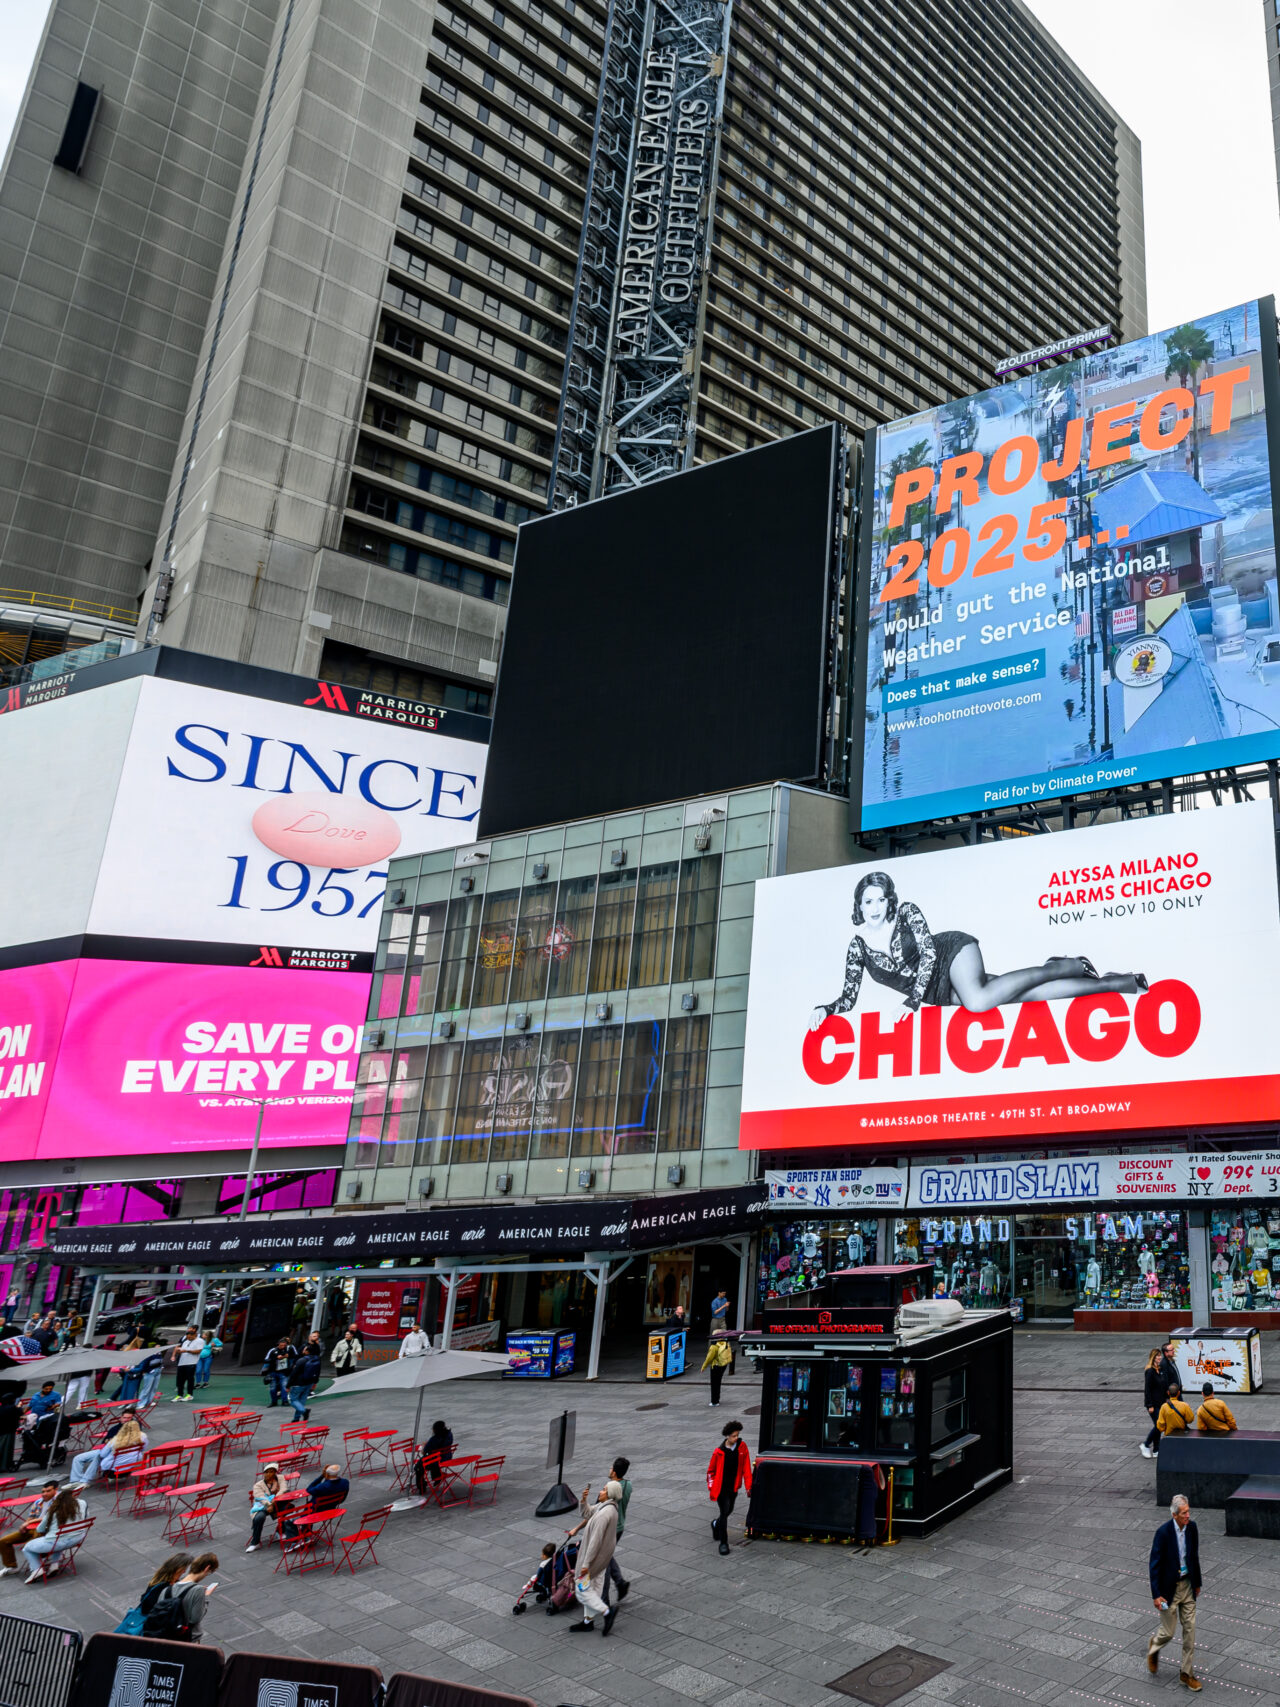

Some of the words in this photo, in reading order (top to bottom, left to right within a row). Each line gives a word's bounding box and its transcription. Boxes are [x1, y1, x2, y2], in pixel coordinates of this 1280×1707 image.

[888, 366, 1250, 529] PROJECT
[883, 604, 943, 637] would
[956, 593, 994, 623] gut
[1008, 581, 1047, 605] the
[1060, 547, 1171, 592] National
[883, 633, 967, 668] Weather
[980, 608, 1071, 645] Service
[28, 673, 76, 693] MARRIOTT
[886, 688, 917, 704] Does
[921, 680, 951, 697] that
[955, 671, 987, 690] make
[991, 658, 1040, 681] sense?
[25, 687, 67, 706] MARQUIS
[361, 692, 448, 719] MARRIOTT
[359, 704, 436, 729] MARQUIS
[886, 691, 1042, 734] www.toohotnottovote.com
[166, 723, 481, 823] SINCE
[984, 787, 1010, 803] Paid
[1011, 784, 1030, 798] for
[1032, 781, 1045, 797] by
[1048, 772, 1094, 791] Climate
[1096, 765, 1138, 782] Power
[283, 810, 368, 842] Dove
[1048, 864, 1115, 888] ALYSSA
[1120, 852, 1199, 878] MILANO
[1038, 885, 1115, 909] CHARMS
[1120, 872, 1212, 898] CHICAGO
[1049, 910, 1085, 925] NOW
[1103, 903, 1136, 918] NOV
[1141, 901, 1156, 914] 10
[1162, 894, 1203, 911] ONLY
[290, 958, 349, 969] MARQUIS
[291, 949, 357, 962] MARRIOTT
[182, 1022, 312, 1054] SAVE
[802, 978, 1202, 1085] CHICAGO
[120, 1060, 296, 1094] EVERY
[198, 1099, 223, 1108] VS.
[297, 1096, 354, 1105] VERIZON
[868, 1114, 938, 1127] AMBASSADOR
[942, 1111, 987, 1122] THEATRE
[999, 1107, 1026, 1119] 49TH
[1029, 1107, 1046, 1118] ST.
[1049, 1105, 1063, 1116] AT
[1066, 1101, 1132, 1115] BROADWAY
[1118, 1159, 1174, 1170] DISCOUNT
[1188, 1155, 1198, 1163] #1
[1201, 1154, 1225, 1163] Rated
[1227, 1153, 1263, 1162] Souvenir
[786, 1171, 818, 1183] SPORTS
[820, 1170, 838, 1182] FAN
[840, 1169, 863, 1181] SHOP
[919, 1167, 1014, 1204] GRAND
[1016, 1162, 1100, 1199] SLAM
[1124, 1172, 1155, 1182] GIFTS
[1156, 1172, 1164, 1181] &
[1223, 1164, 1254, 1179] 99¢
[1116, 1183, 1177, 1194] SOUVENIRS
[1187, 1182, 1214, 1196] NY
[1223, 1183, 1253, 1195] Dept.
[1268, 1178, 1278, 1192] 3
[631, 1210, 696, 1230] AMERICAN
[702, 1205, 737, 1219] EAGLE
[926, 1219, 1010, 1245] GRAND
[1066, 1215, 1144, 1241] SLAM
[90, 1243, 112, 1253] EAGLE
[144, 1241, 184, 1251] AMERICAN
[186, 1240, 212, 1250] EAGLE
[250, 1237, 294, 1248] AMERICAN
[297, 1236, 325, 1247] EAGLE
[367, 1232, 416, 1244] AMERICAN
[420, 1230, 449, 1242] EAGLE
[498, 1227, 553, 1240] AMERICAN
[557, 1225, 590, 1238] EAGLE
[769, 1325, 785, 1333] THE
[785, 1325, 819, 1333] OFFICIAL
[820, 1324, 884, 1333] PHOTOGRAPHER
[1187, 1359, 1216, 1367] BLACK
[1195, 1366, 1224, 1375] EVENT
[152, 1674, 175, 1687] TIMES
[145, 1688, 174, 1702] SQUARE
